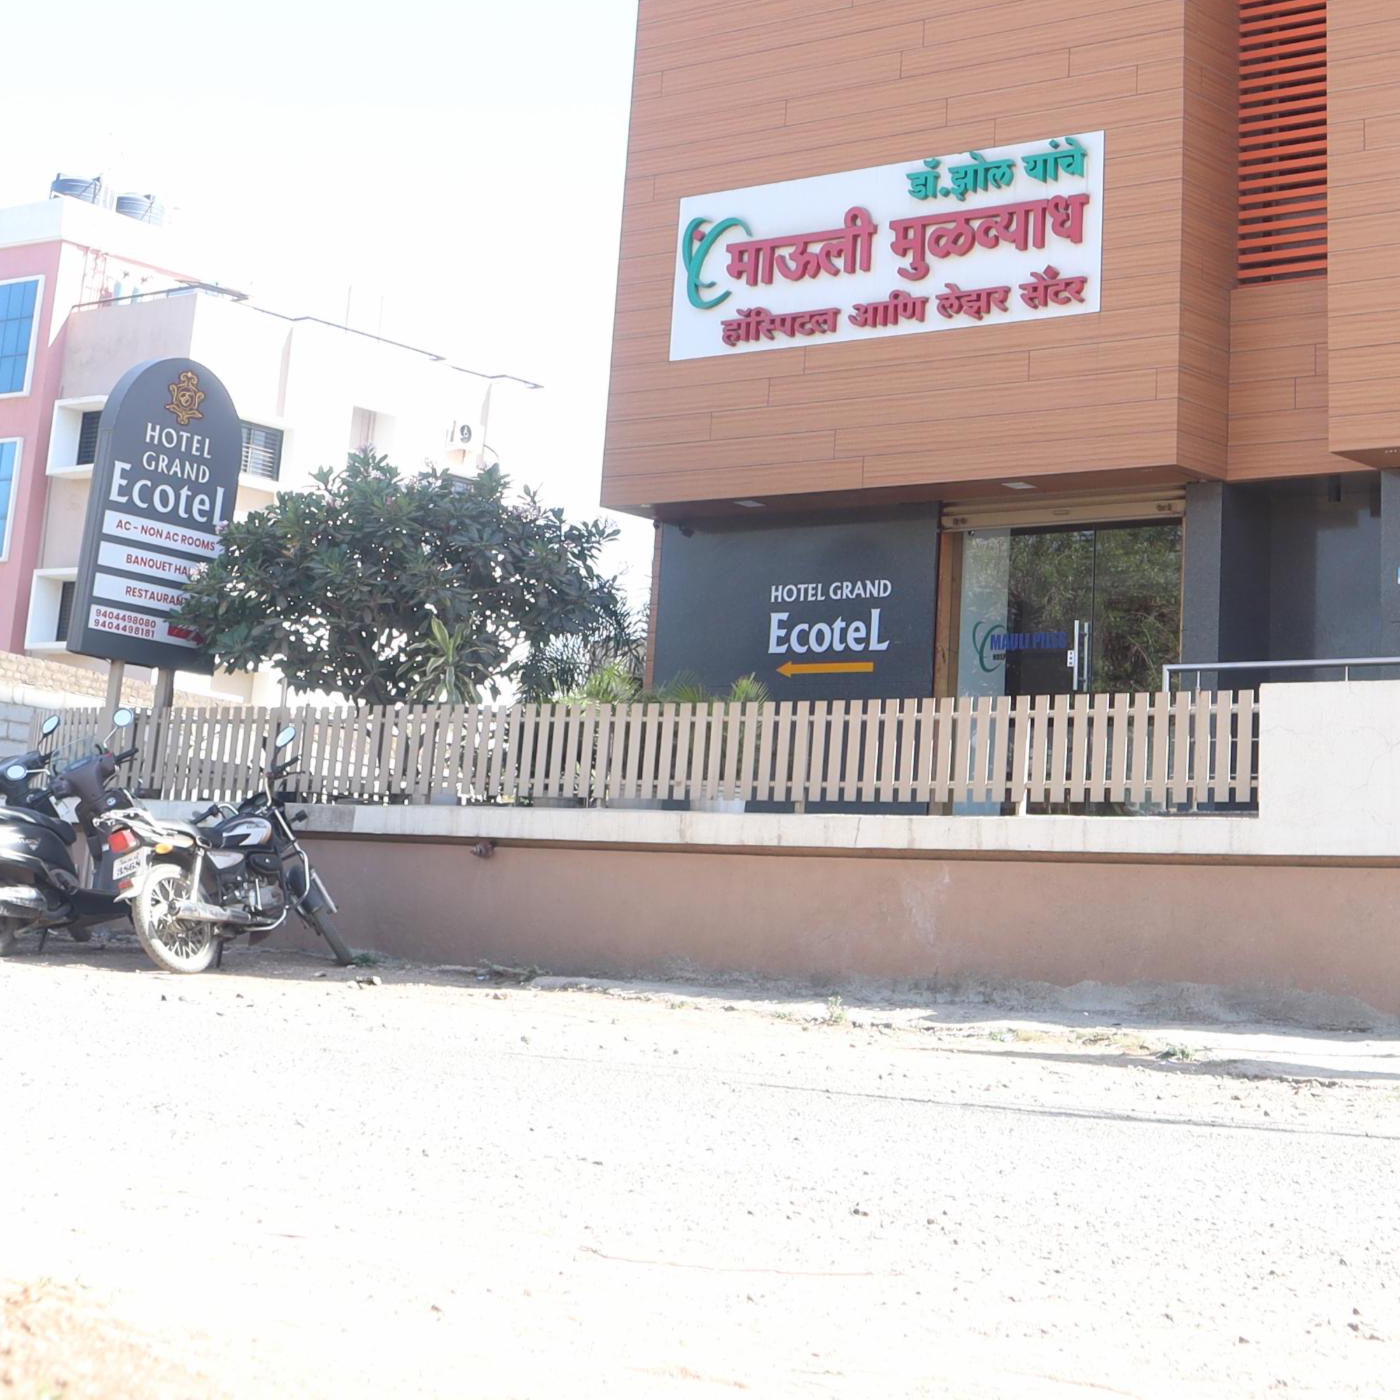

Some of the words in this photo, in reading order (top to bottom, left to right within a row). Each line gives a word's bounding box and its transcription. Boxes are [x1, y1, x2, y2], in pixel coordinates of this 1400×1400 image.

[1021, 137, 1087, 184] यांचे
[726, 206, 878, 287] माऊली
[889, 193, 1090, 282] मुळव्याध
[721, 306, 841, 347] हॉस्पिटल
[848, 289, 930, 328] आणि
[1018, 264, 1088, 309] सेंटर
[145, 422, 212, 459] HOTEL
[142, 451, 210, 484] GRAND
[116, 519, 132, 531] AC
[140, 525, 164, 539] NON
[164, 531, 180, 543] AC
[180, 534, 216, 552] ROOMS
[125, 553, 174, 573] BANQUET
[125, 585, 186, 607] RESTAURAN
[770, 583, 826, 603] HOTEL
[829, 579, 892, 600] GRAND
